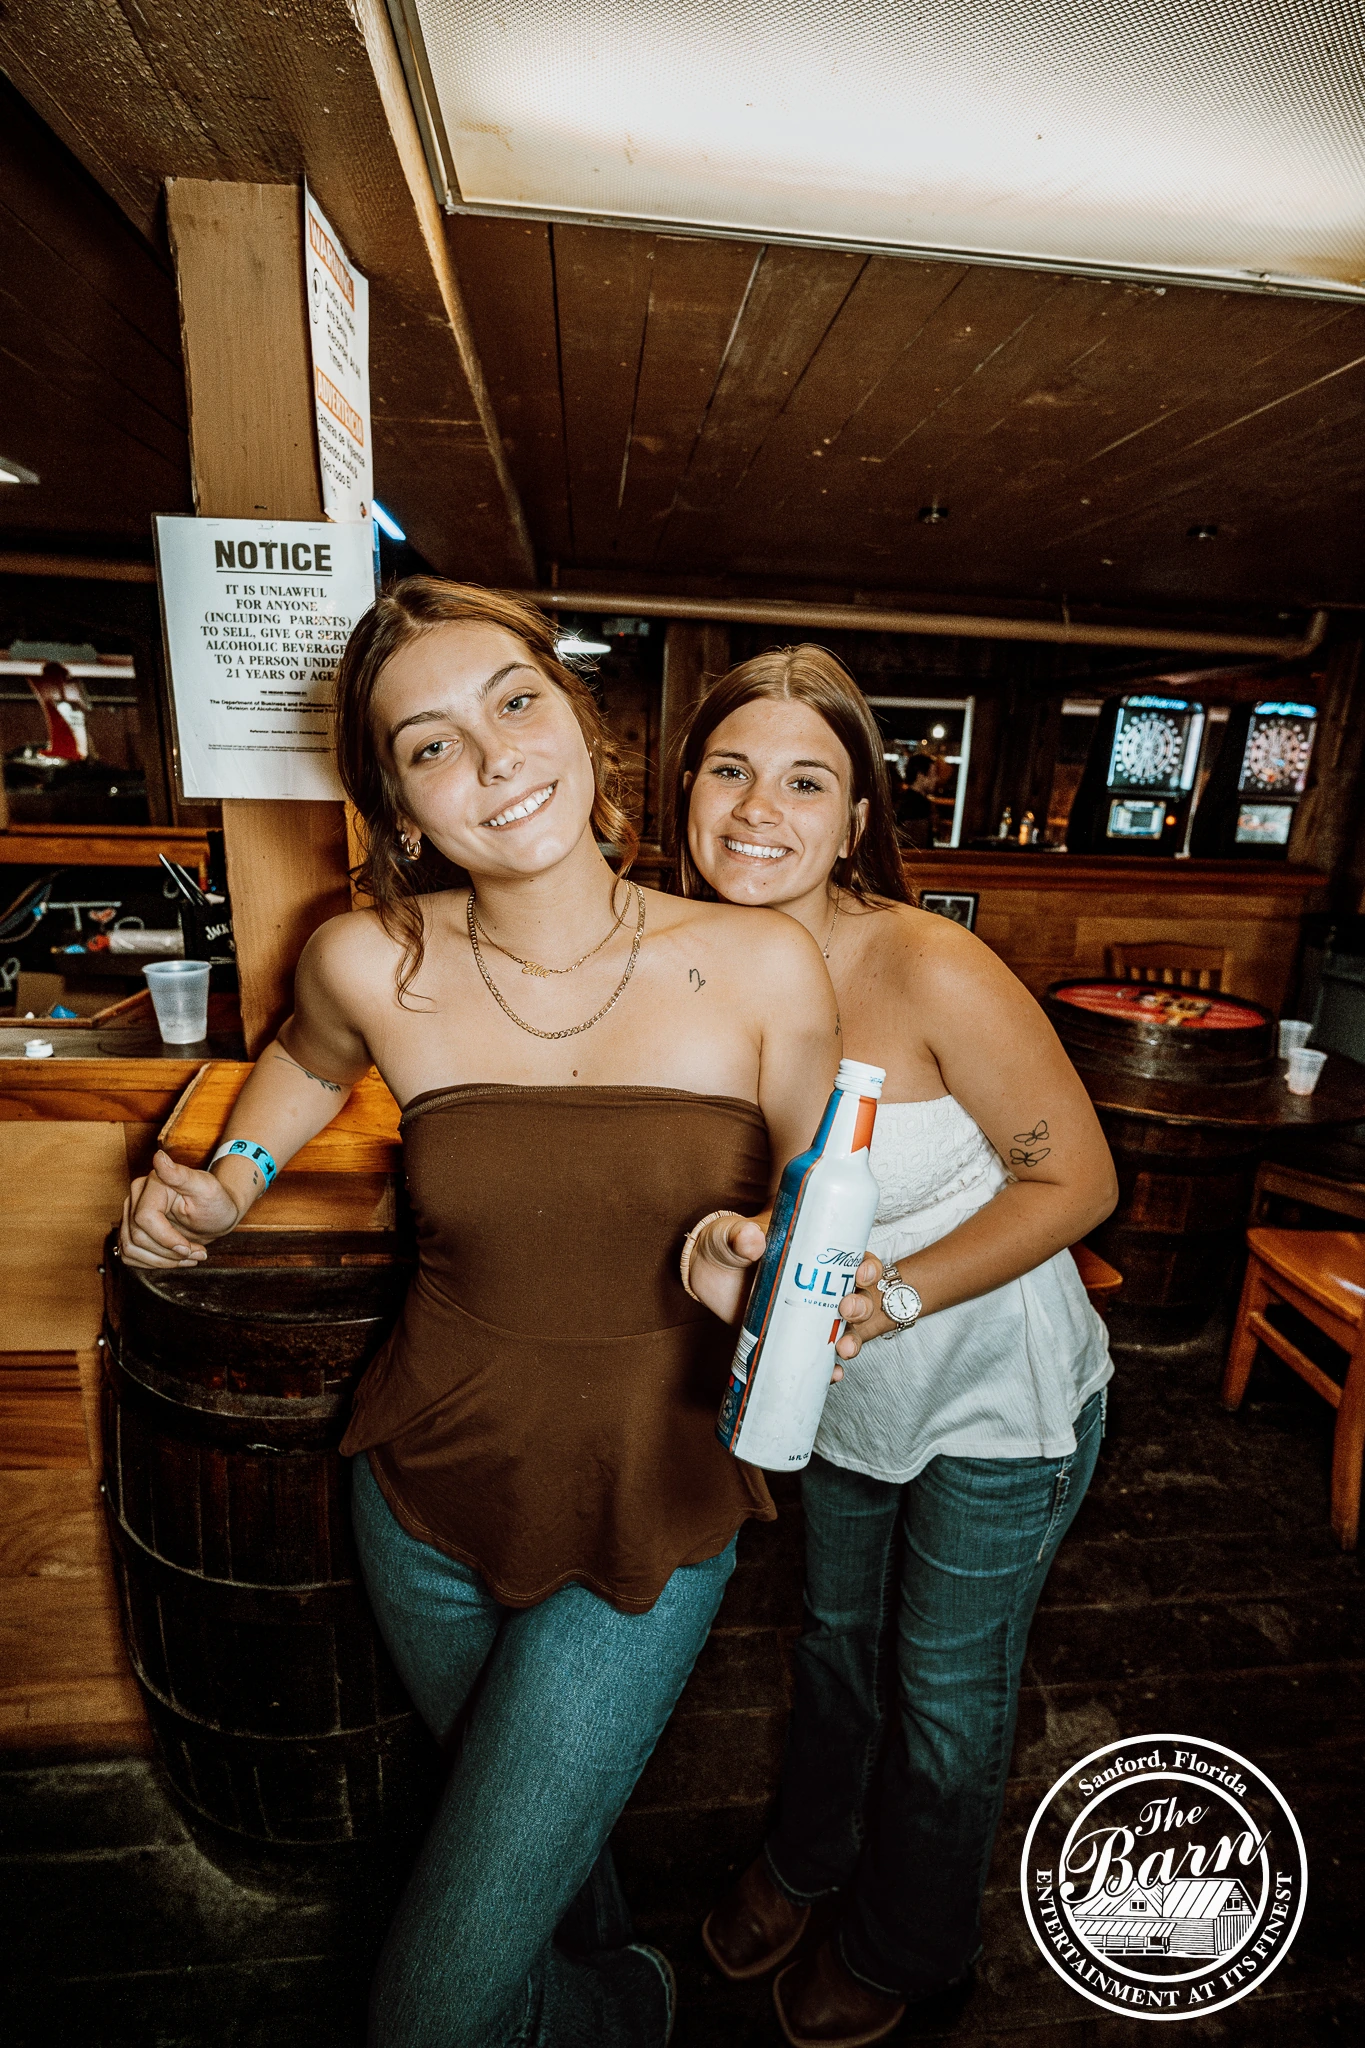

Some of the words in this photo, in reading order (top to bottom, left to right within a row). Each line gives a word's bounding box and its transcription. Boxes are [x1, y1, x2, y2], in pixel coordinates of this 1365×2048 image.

[309, 215, 353, 303] WARNING
[317, 374, 364, 442] ADVERTENCIA
[214, 540, 332, 572] NOTICE
[225, 584, 239, 595] IT
[243, 585, 256, 596] IS
[260, 585, 327, 598] UNLAWFUL
[236, 599, 262, 610] FOR
[266, 600, 318, 612] ANYONE
[204, 611, 281, 625] (INCLUDING
[290, 615, 352, 629] PARENTS)
[200, 626, 219, 637] TO
[223, 627, 256, 640] SELL,
[260, 628, 291, 639] GIVE
[295, 629, 313, 640] OR
[317, 630, 352, 641] SERV
[206, 640, 278, 653] ALCOHOLIC
[282, 643, 347, 655] BEVERAGE
[214, 654, 232, 665] TO
[237, 655, 245, 665] A
[250, 656, 299, 667] PERSON
[303, 657, 340, 668] UNDE
[226, 669, 240, 679] 21
[246, 670, 285, 680] YEARS
[289, 671, 306, 681] OF
[310, 671, 335, 682] AGE
[794, 1262, 857, 1297] ULT
